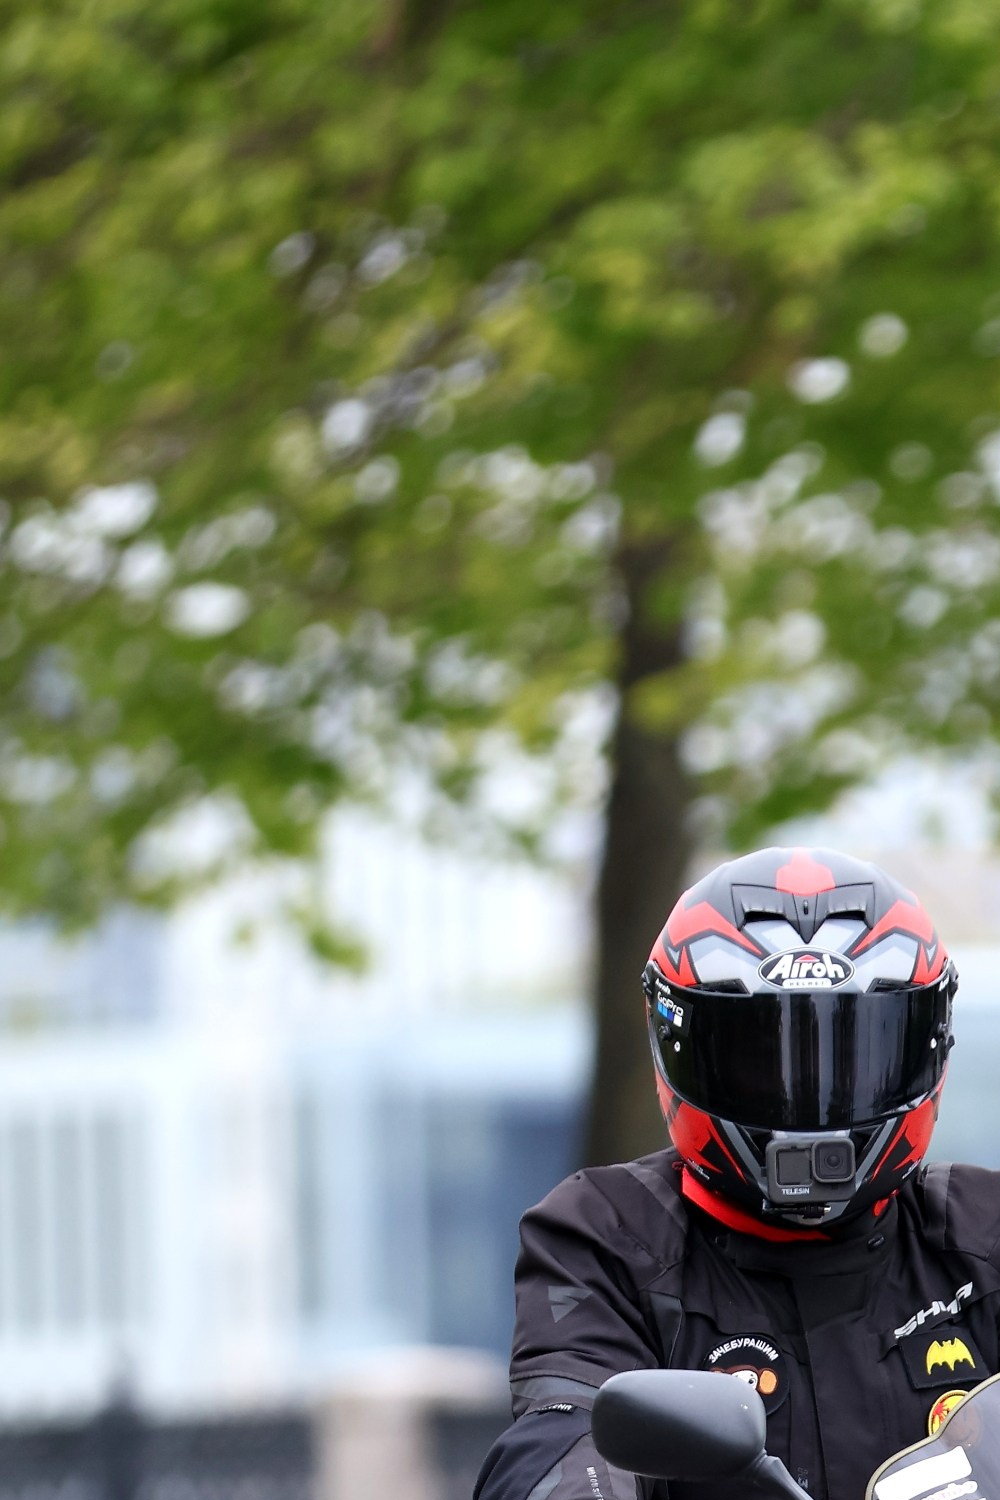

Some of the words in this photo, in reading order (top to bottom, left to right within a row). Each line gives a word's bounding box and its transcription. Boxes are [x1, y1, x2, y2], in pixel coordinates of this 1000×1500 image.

[766, 954, 845, 980] Airoh
[657, 991, 684, 1017] GoPro
[782, 1187, 810, 1195] TELESIN
[708, 1338, 779, 1363] ЗАЧЕБУРАШИМ
